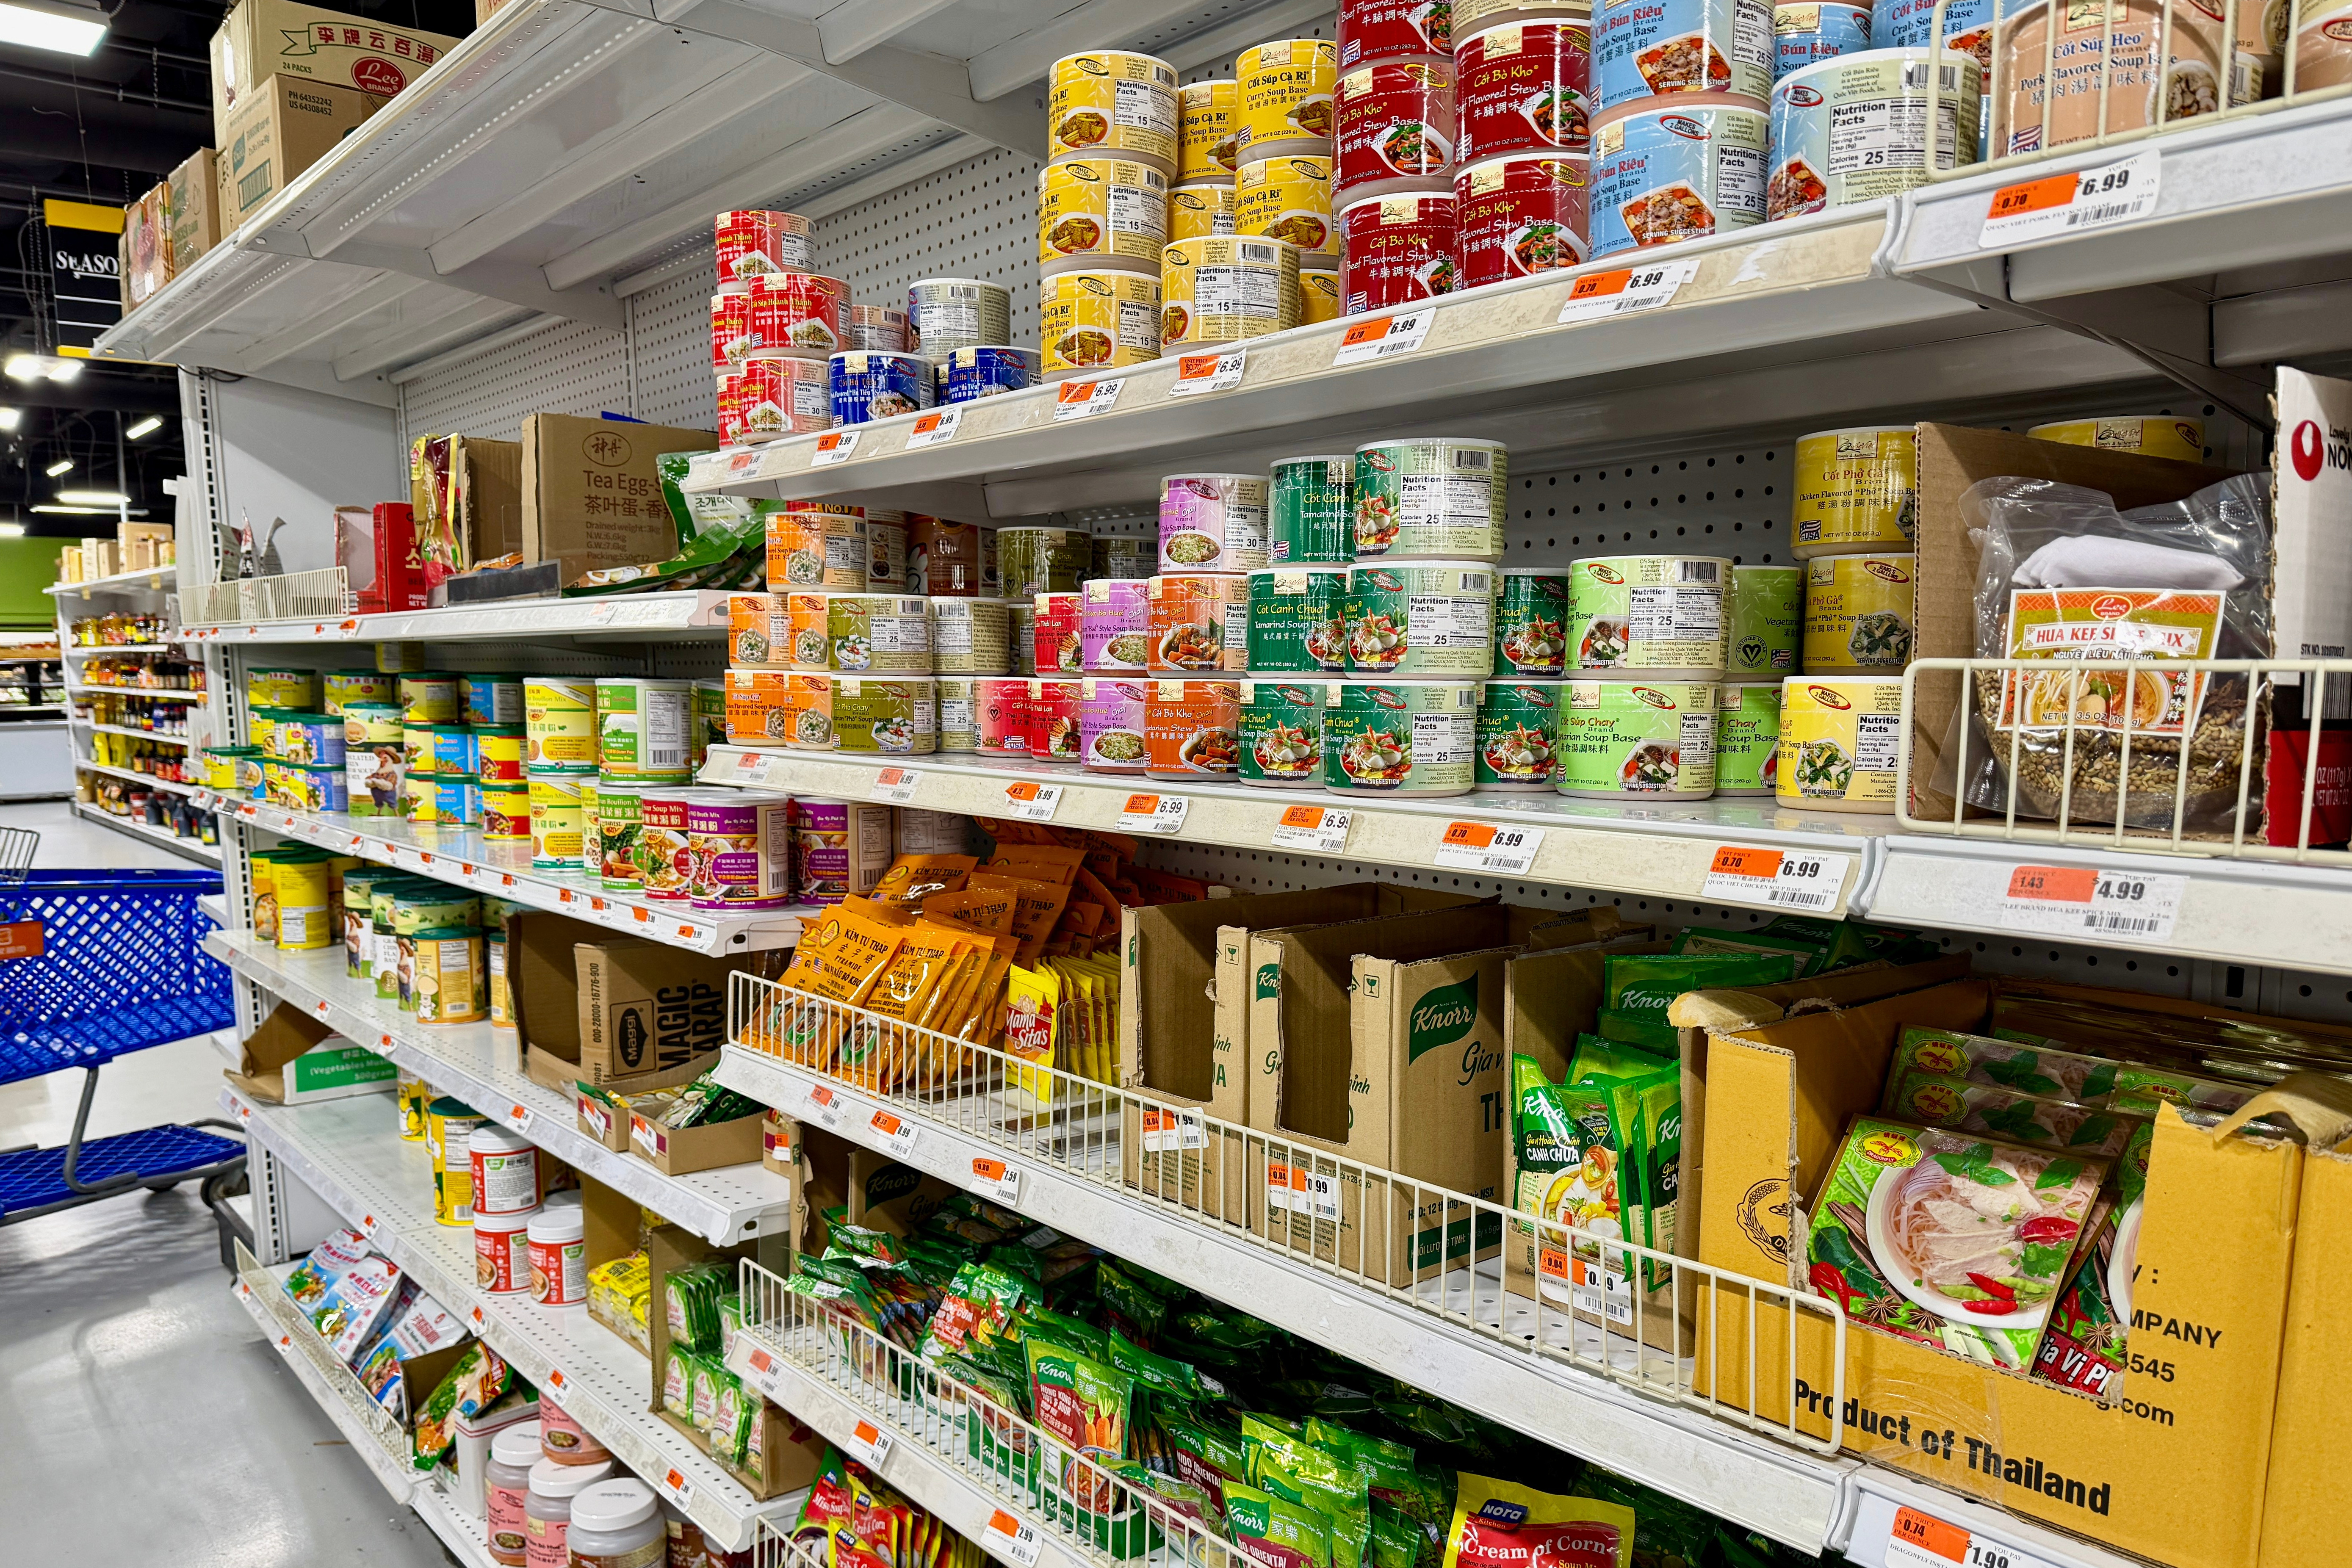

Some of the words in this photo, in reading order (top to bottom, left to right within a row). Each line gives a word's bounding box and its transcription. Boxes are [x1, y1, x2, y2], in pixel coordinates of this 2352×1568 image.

[1609, 14, 1630, 30] Bún
[1633, 5, 1663, 19] Riêu
[1596, 39, 1611, 54] Crab
[1634, 25, 1657, 37] Base
[2112, 33, 2142, 47] Heo
[292, 63, 312, 73] PACKS
[2111, 55, 2144, 67] Soup
[360, 64, 398, 85] Lee
[1248, 77, 1259, 89] Cốt
[1261, 75, 1277, 86] Súp
[1280, 72, 1292, 84] Cà
[1295, 71, 1306, 81] Ri
[1475, 73, 1490, 87] Cốt
[1493, 69, 1508, 83] Bò
[1511, 65, 1534, 77] Kho
[367, 83, 392, 93] BRAND
[1117, 80, 1148, 90] Nutrition
[289, 91, 298, 100] PH
[299, 93, 332, 107] 64352242
[1116, 88, 1137, 97] Facts
[1247, 92, 1265, 102] Curry
[1267, 88, 1286, 100] Soup
[1288, 86, 1308, 94] Base
[1469, 90, 1507, 107] Flavored
[1509, 85, 1539, 97] Stew
[289, 100, 299, 109] US
[299, 102, 332, 116] 64308452
[1832, 102, 1886, 117] Nutrition
[1137, 115, 1148, 125] 15
[1678, 120, 1696, 130] MAKES
[1832, 115, 1865, 127] Facts
[1675, 124, 1699, 136] GALLONS
[1831, 137, 1852, 145] Serving
[1829, 156, 1859, 165] Calories
[1864, 152, 1884, 165] 25
[1389, 235, 1405, 247] Bò
[1408, 233, 1428, 246] Kho
[56, 250, 120, 274] SEASO
[1362, 251, 1403, 267] Flavored
[1406, 250, 1433, 263] Stew
[1218, 302, 1229, 312] 15
[1352, 303, 1367, 313] USA
[2330, 425, 2350, 442] Lovely
[584, 470, 613, 489] Tea
[1823, 471, 1840, 481] Cốt
[1843, 469, 1864, 480] Phở
[1800, 492, 1819, 501] Chicken
[1821, 489, 1852, 498] Flavored
[1425, 514, 1439, 524] 25
[1246, 538, 1257, 547] 30
[1257, 605, 1271, 613] Cốt
[1271, 605, 1293, 613] Canh
[1297, 604, 1323, 613] Chua
[2096, 597, 2128, 612] Lee
[1287, 621, 1307, 629] Soup
[1657, 615, 1672, 626] 25
[2036, 629, 2064, 643] HUA
[2070, 628, 2097, 640] KEE
[2300, 644, 2311, 654] STK
[1164, 709, 1174, 718] Bò
[1176, 709, 1193, 718] Kho
[1196, 709, 1213, 718] Chay
[1571, 718, 1586, 727] Súp
[1588, 718, 1616, 728] Chay
[1583, 733, 1609, 742] Soup
[1436, 751, 1448, 761] 25
[1006, 1008, 1035, 1034] Mama
[1413, 1006, 1472, 1034] Knorr
[627, 1016, 638, 1061] Maggi
[1015, 1026, 1049, 1050] Sita's
[1458, 1040, 1491, 1085] Gia
[1526, 1148, 1549, 1162] CANH
[1550, 1148, 1580, 1162] CHUA
[1866, 1149, 1896, 1164] DRAGONFLY
[1038, 1362, 1074, 1385] Knorr
[1795, 1379, 1910, 1445] Product
[1922, 1426, 1955, 1462] of
[1964, 1438, 2111, 1516] Thailand
[1271, 1520, 1299, 1542] 家樂
[1478, 1518, 1506, 1530] Kitchen
[1465, 1539, 1528, 1559] Cream
[1534, 1539, 1552, 1556] of
[1557, 1535, 1605, 1554] Corn
[1994, 1545, 2009, 1555] YOU
[2010, 1551, 2022, 1562] PAY
